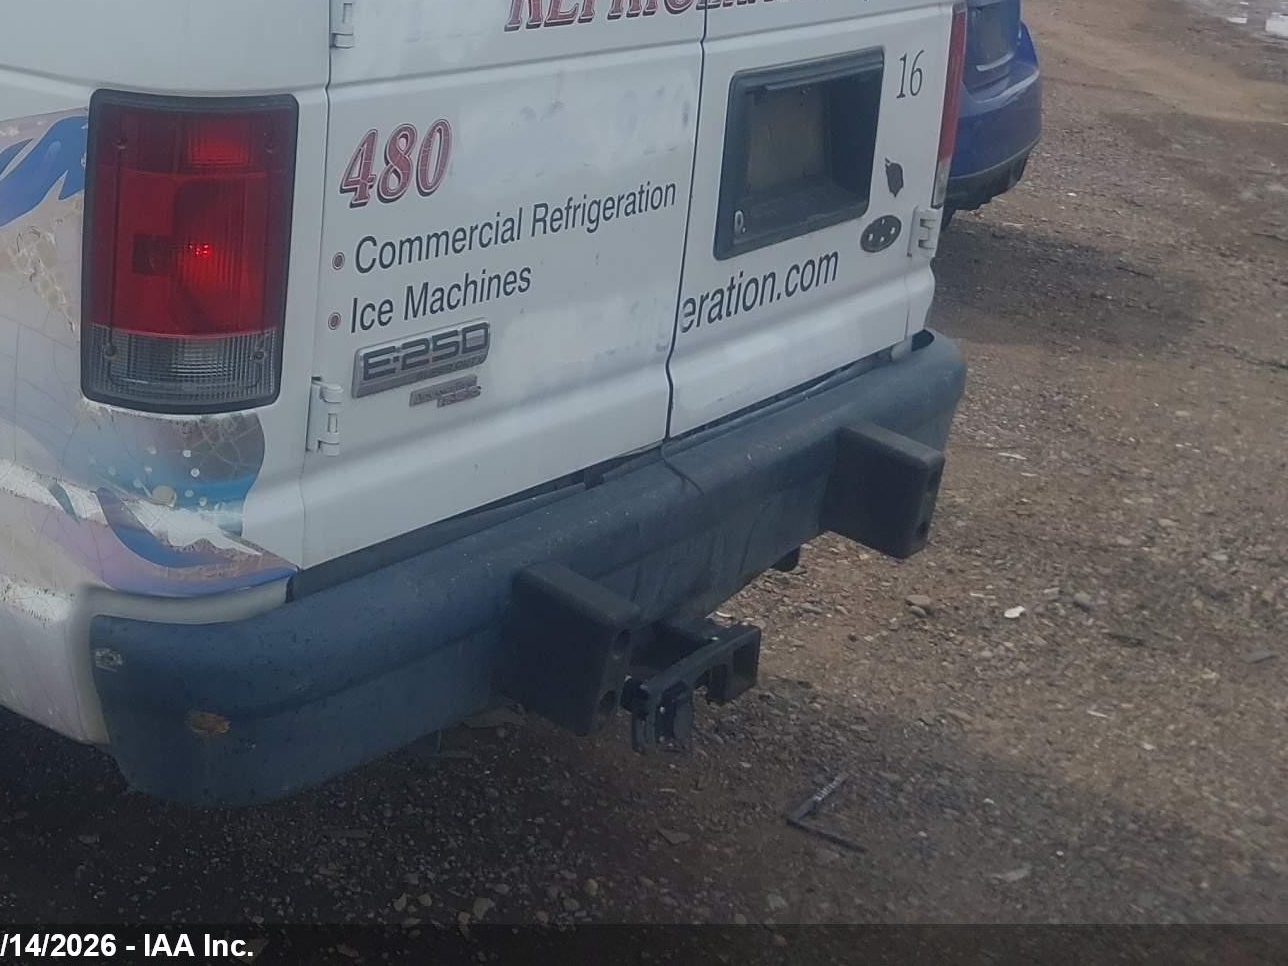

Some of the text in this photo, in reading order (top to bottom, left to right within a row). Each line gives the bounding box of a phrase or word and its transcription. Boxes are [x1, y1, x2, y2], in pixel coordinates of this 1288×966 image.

[896, 48, 925, 100] 16
[338, 118, 454, 210] 480
[354, 179, 678, 275] Commercial Refrigeration
[350, 265, 533, 335] Ice Machines
[680, 250, 840, 334] eration.com
